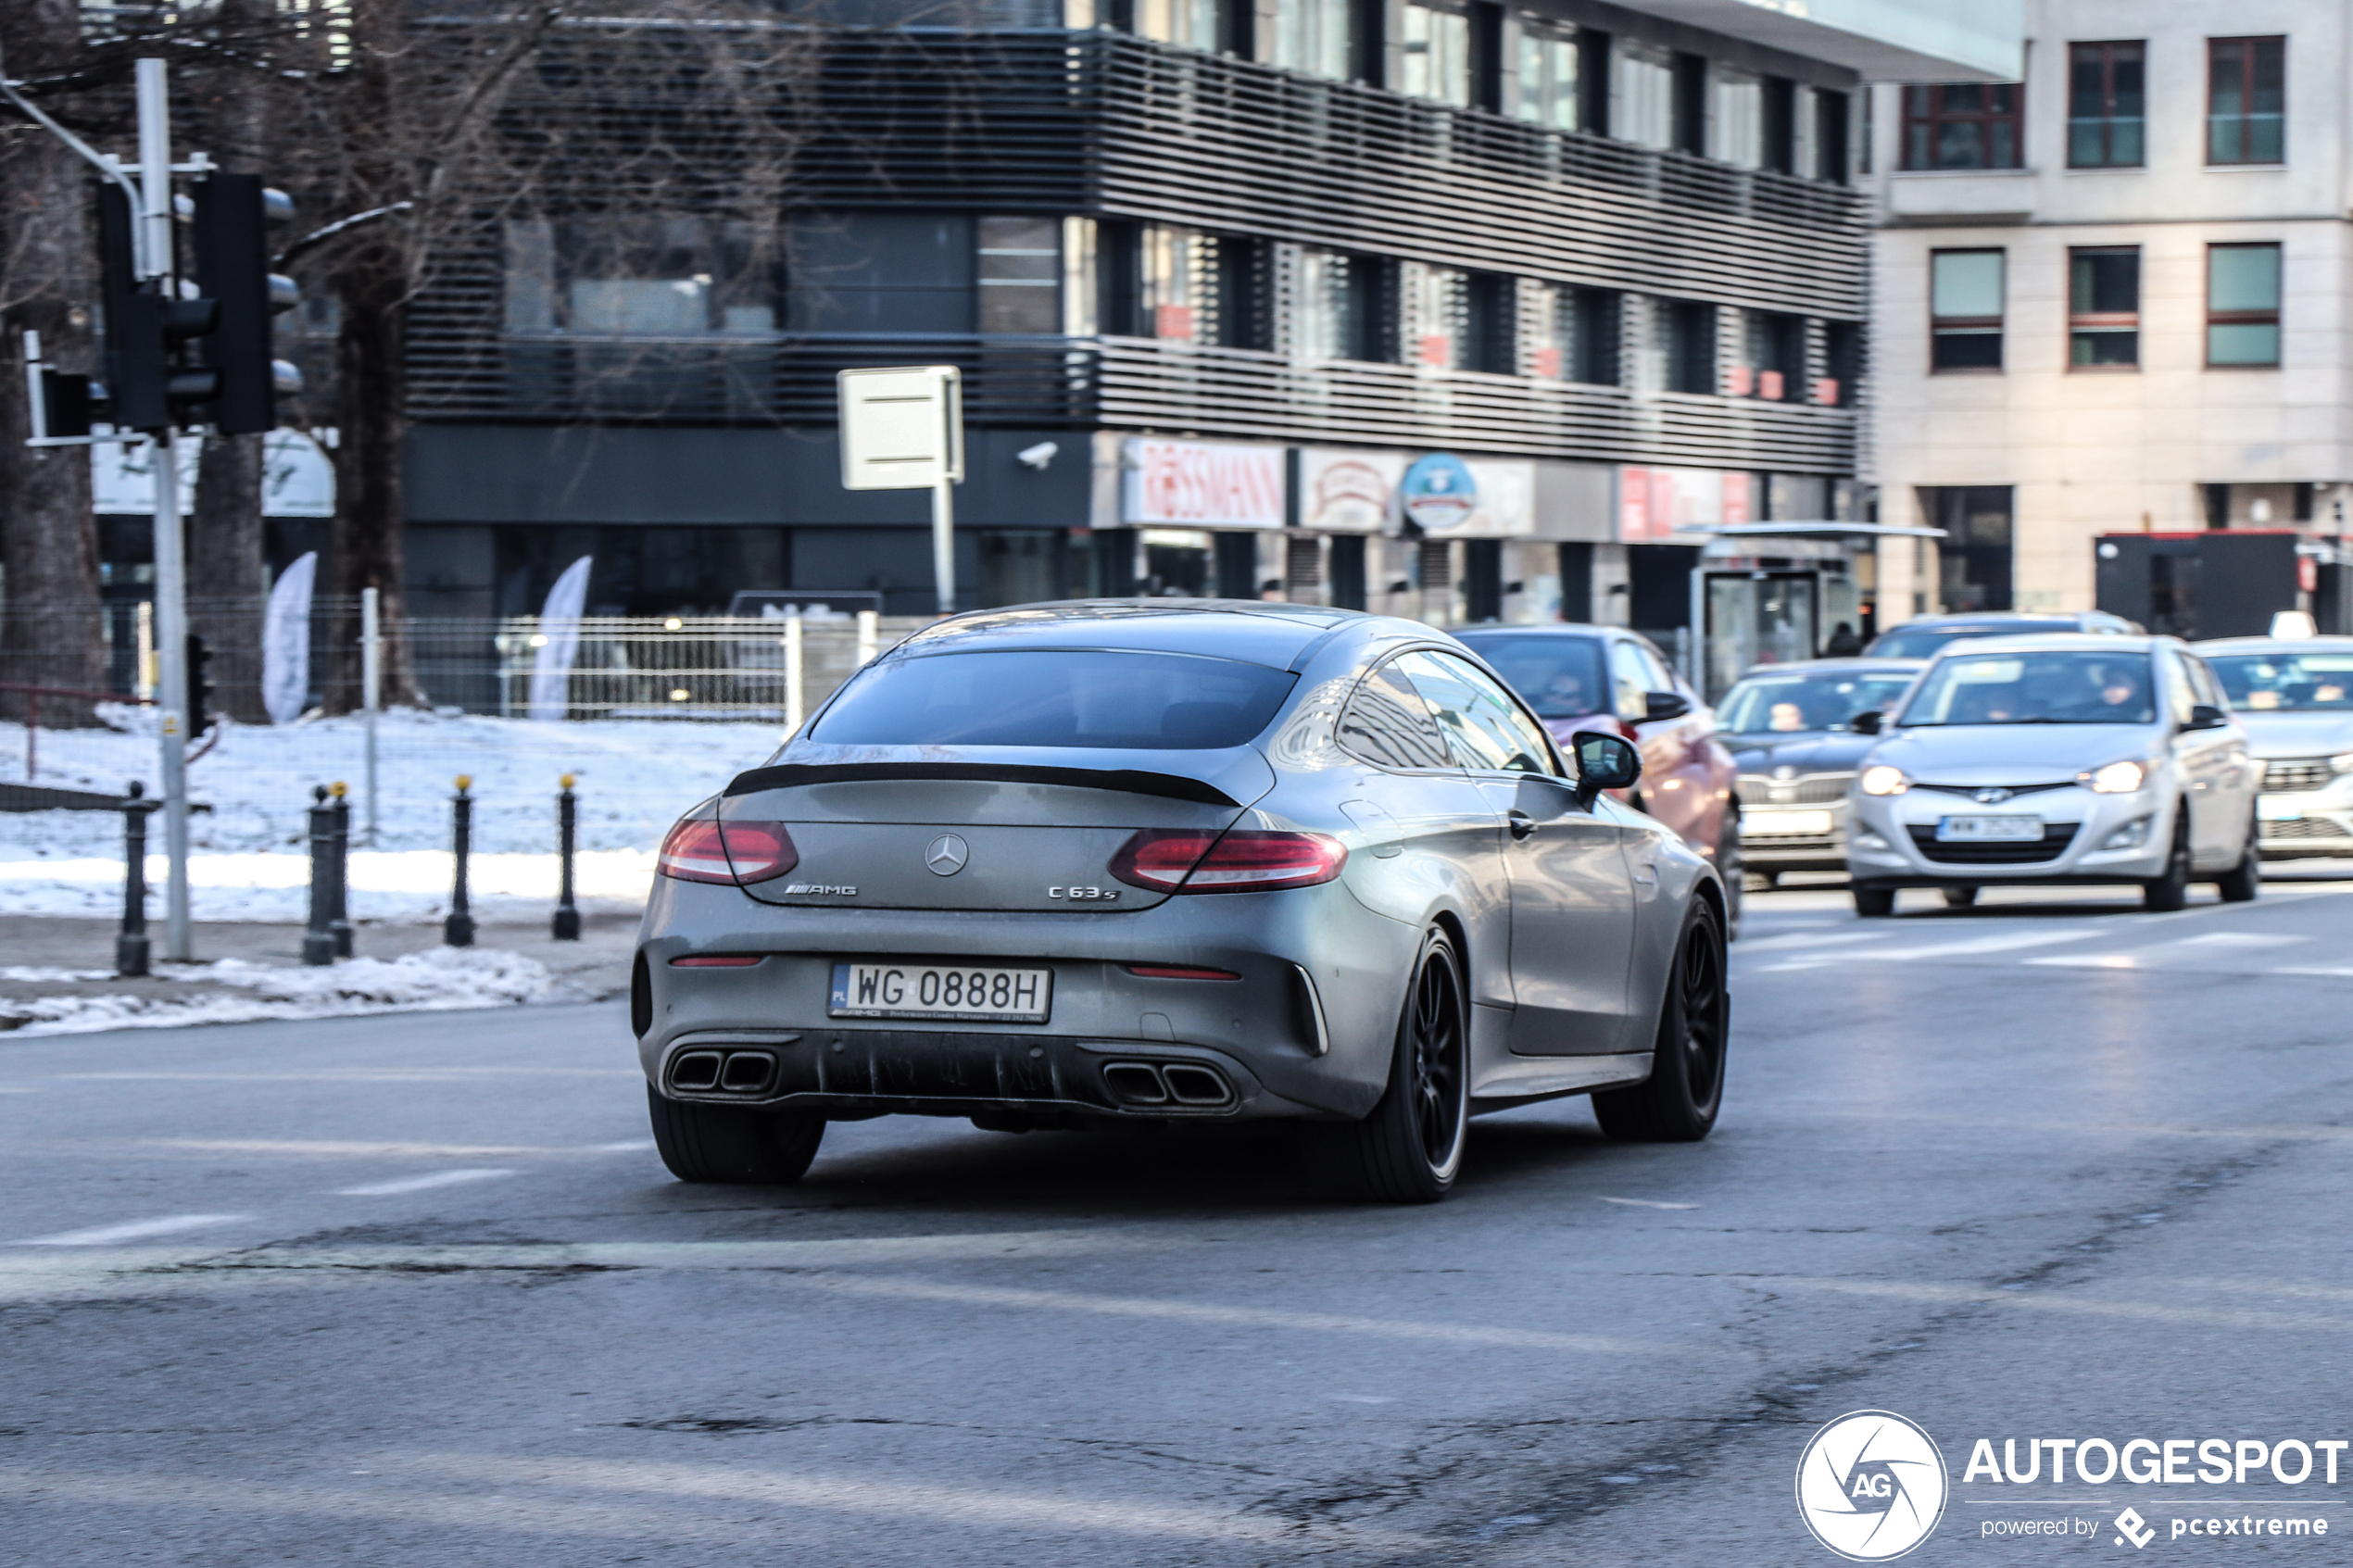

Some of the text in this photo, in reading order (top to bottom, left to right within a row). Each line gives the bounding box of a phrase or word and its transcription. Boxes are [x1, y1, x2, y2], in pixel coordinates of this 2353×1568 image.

[808, 884, 857, 896] AMG
[1049, 886, 1063, 898] C
[858, 969, 1038, 1010] WG 0888H
[833, 991, 846, 1002] PL
